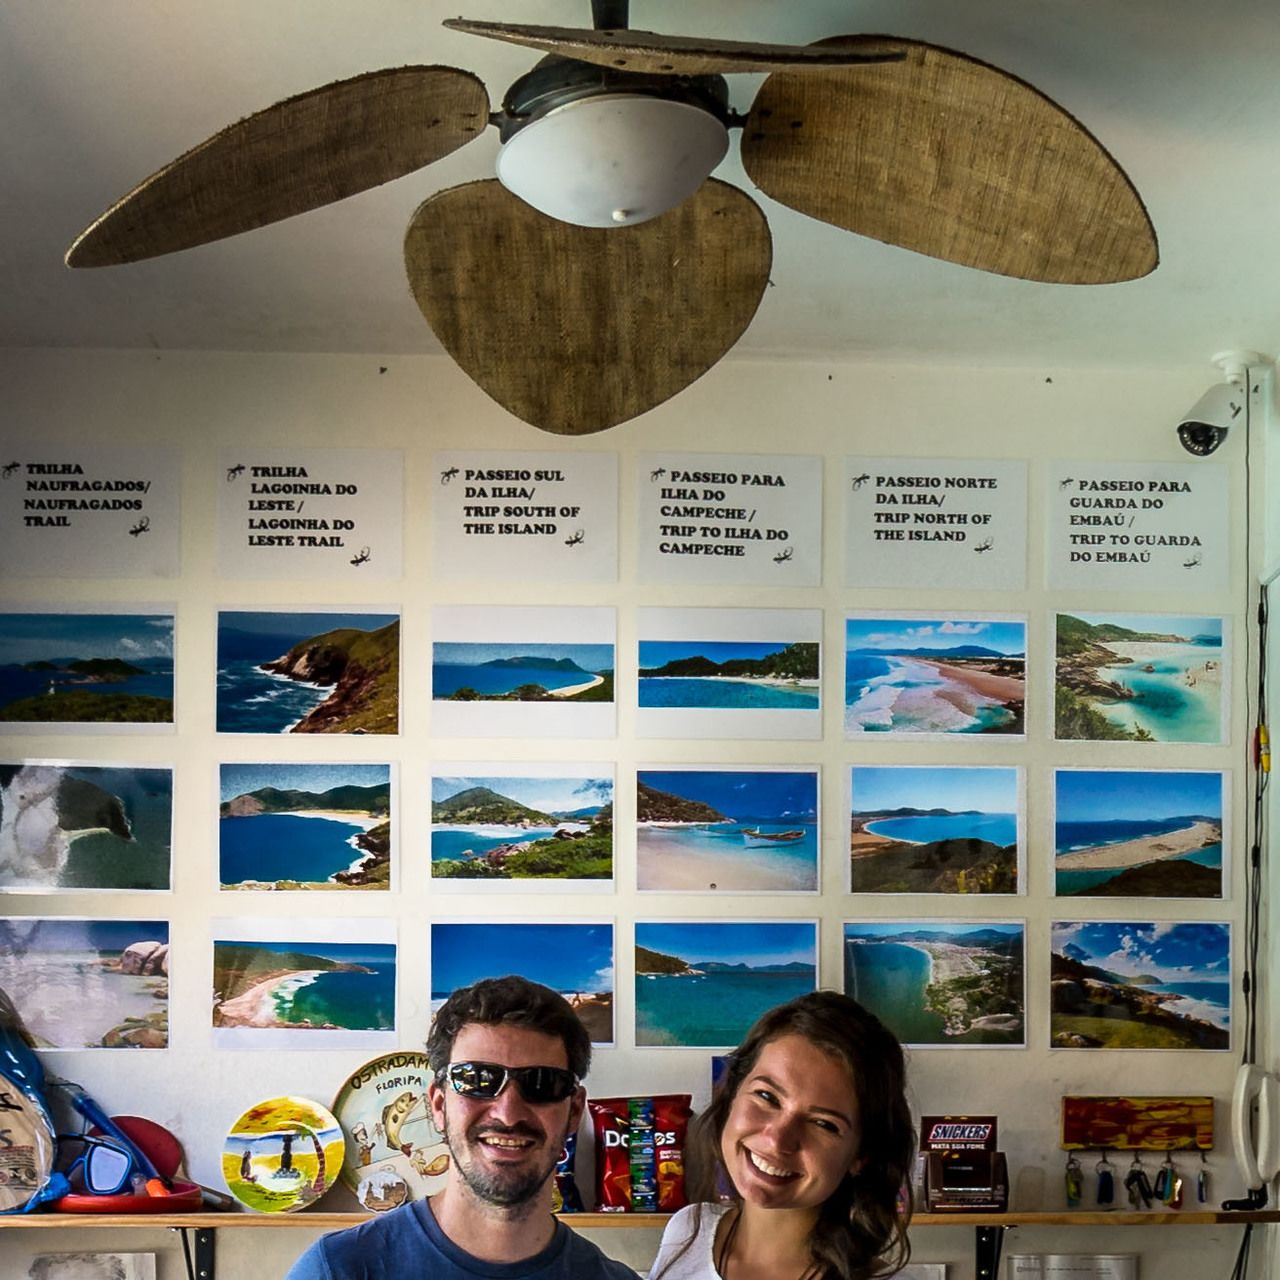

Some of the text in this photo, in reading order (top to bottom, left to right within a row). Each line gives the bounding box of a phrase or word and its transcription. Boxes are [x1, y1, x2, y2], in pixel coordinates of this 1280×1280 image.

[26, 464, 84, 474] TRILHA
[251, 466, 308, 478] TRILHA
[465, 470, 564, 481] PASSEIO SUL
[670, 471, 785, 487] PASSEIO PARA
[876, 476, 998, 489] PASSEIO NORTE
[26, 481, 151, 494] NAUFRAGADOS/
[251, 483, 357, 495] LAGOINHA DO
[1079, 480, 1192, 493] PASSEIO PARA
[465, 487, 535, 500] DA ILHA/
[661, 488, 725, 501] ILHA DO
[876, 493, 946, 507] DA ILHA/
[24, 499, 142, 510] NAUFRAGADOS
[248, 500, 304, 513] LESTE /
[1069, 497, 1164, 509] GUARDA DO
[463, 506, 580, 517] TRIP SOUTH OF
[660, 505, 756, 522] CAMPECHE /
[24, 516, 71, 527] TRAIL
[248, 519, 355, 530] LAGOINHA DO
[874, 512, 992, 525] TRIP NORTH OF
[1070, 513, 1125, 526] EMBAÚ
[463, 523, 557, 534] THE ISLAND
[660, 525, 789, 540] TRIP TO ILHA DO
[248, 535, 344, 547] LESTE TRAIL
[874, 529, 966, 542] THE ISLAND
[1069, 534, 1202, 546] TRIP TO GUARDA
[659, 542, 745, 556] CAMPECHE
[1070, 550, 1151, 563] DO EMBAÚ
[351, 1055, 430, 1090] OSTRADAM
[375, 1075, 422, 1095] FLORIPA
[931, 1125, 989, 1138] SNICKERS
[605, 1130, 675, 1147] Doos
